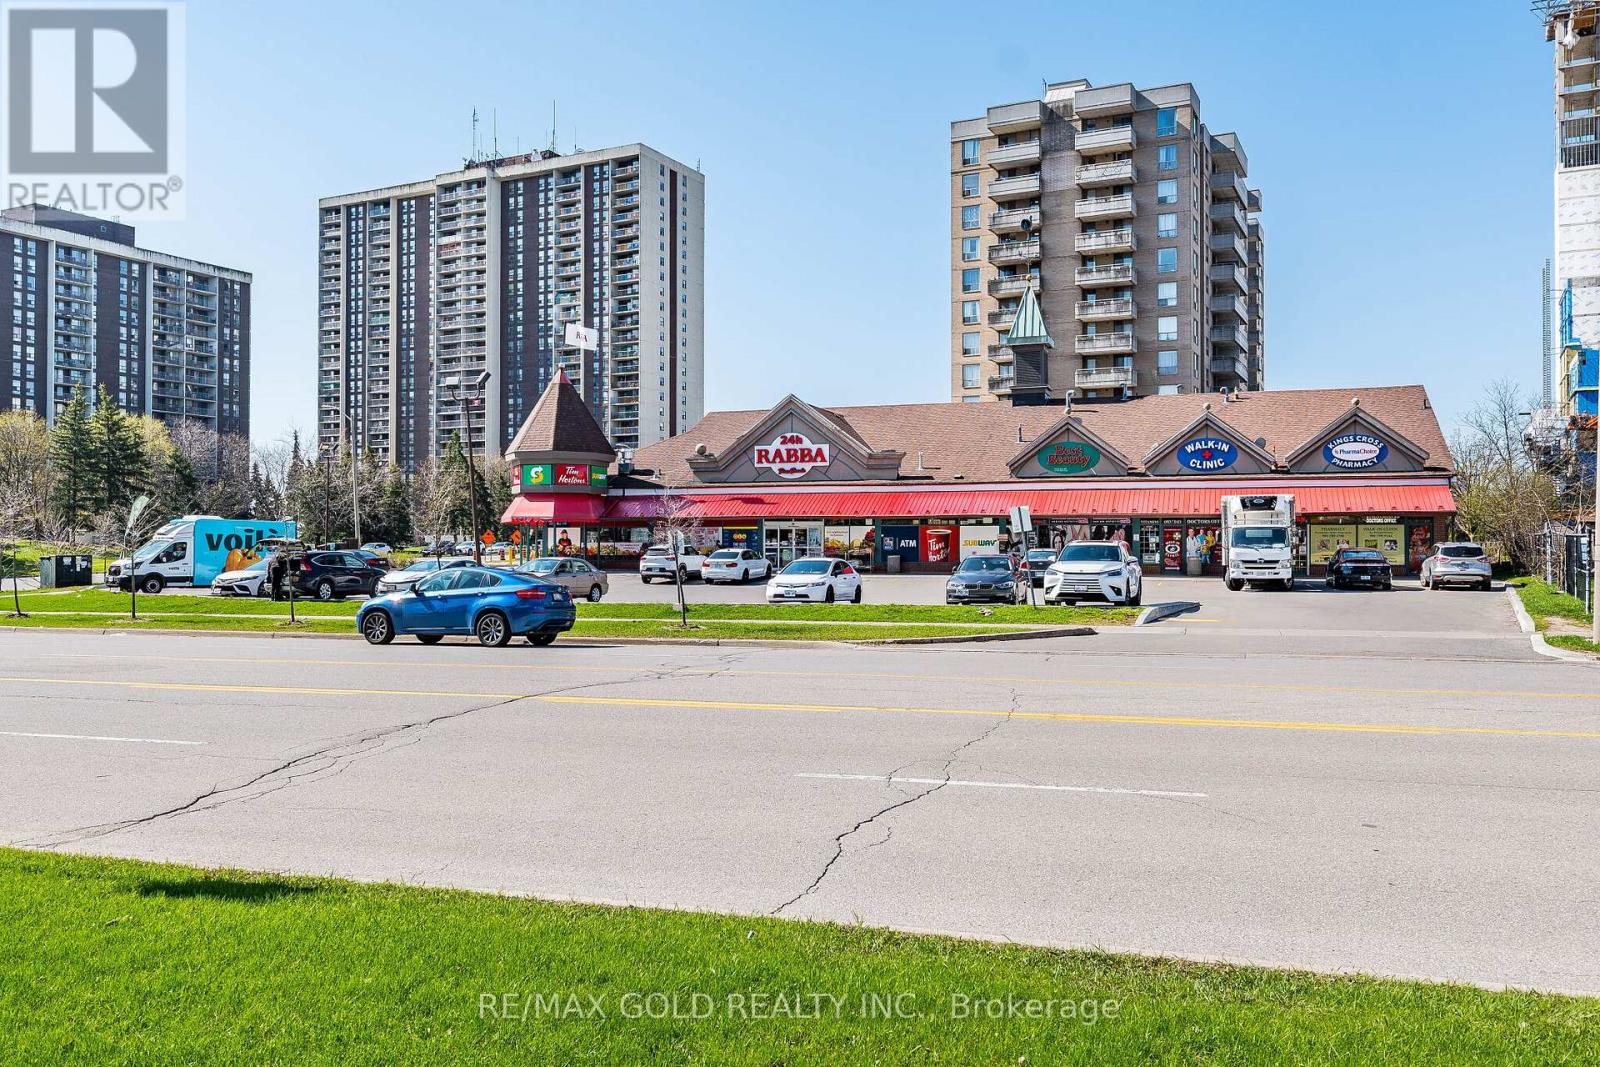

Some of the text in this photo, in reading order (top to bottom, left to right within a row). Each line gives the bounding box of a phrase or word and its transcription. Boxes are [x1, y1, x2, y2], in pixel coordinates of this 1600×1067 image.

[780, 435, 803, 445] 24h
[1327, 435, 1384, 449] KINGS CROSS
[1185, 440, 1229, 453] WALK-IN
[756, 448, 827, 464] RABBA
[1047, 454, 1091, 468] Beauty
[1190, 458, 1225, 469] CLINIC
[1331, 457, 1378, 468] PHARMACY
[565, 466, 579, 475] Tim
[558, 474, 586, 484] Hortons
[900, 539, 917, 547] ATM
[928, 538, 945, 551] Tim
